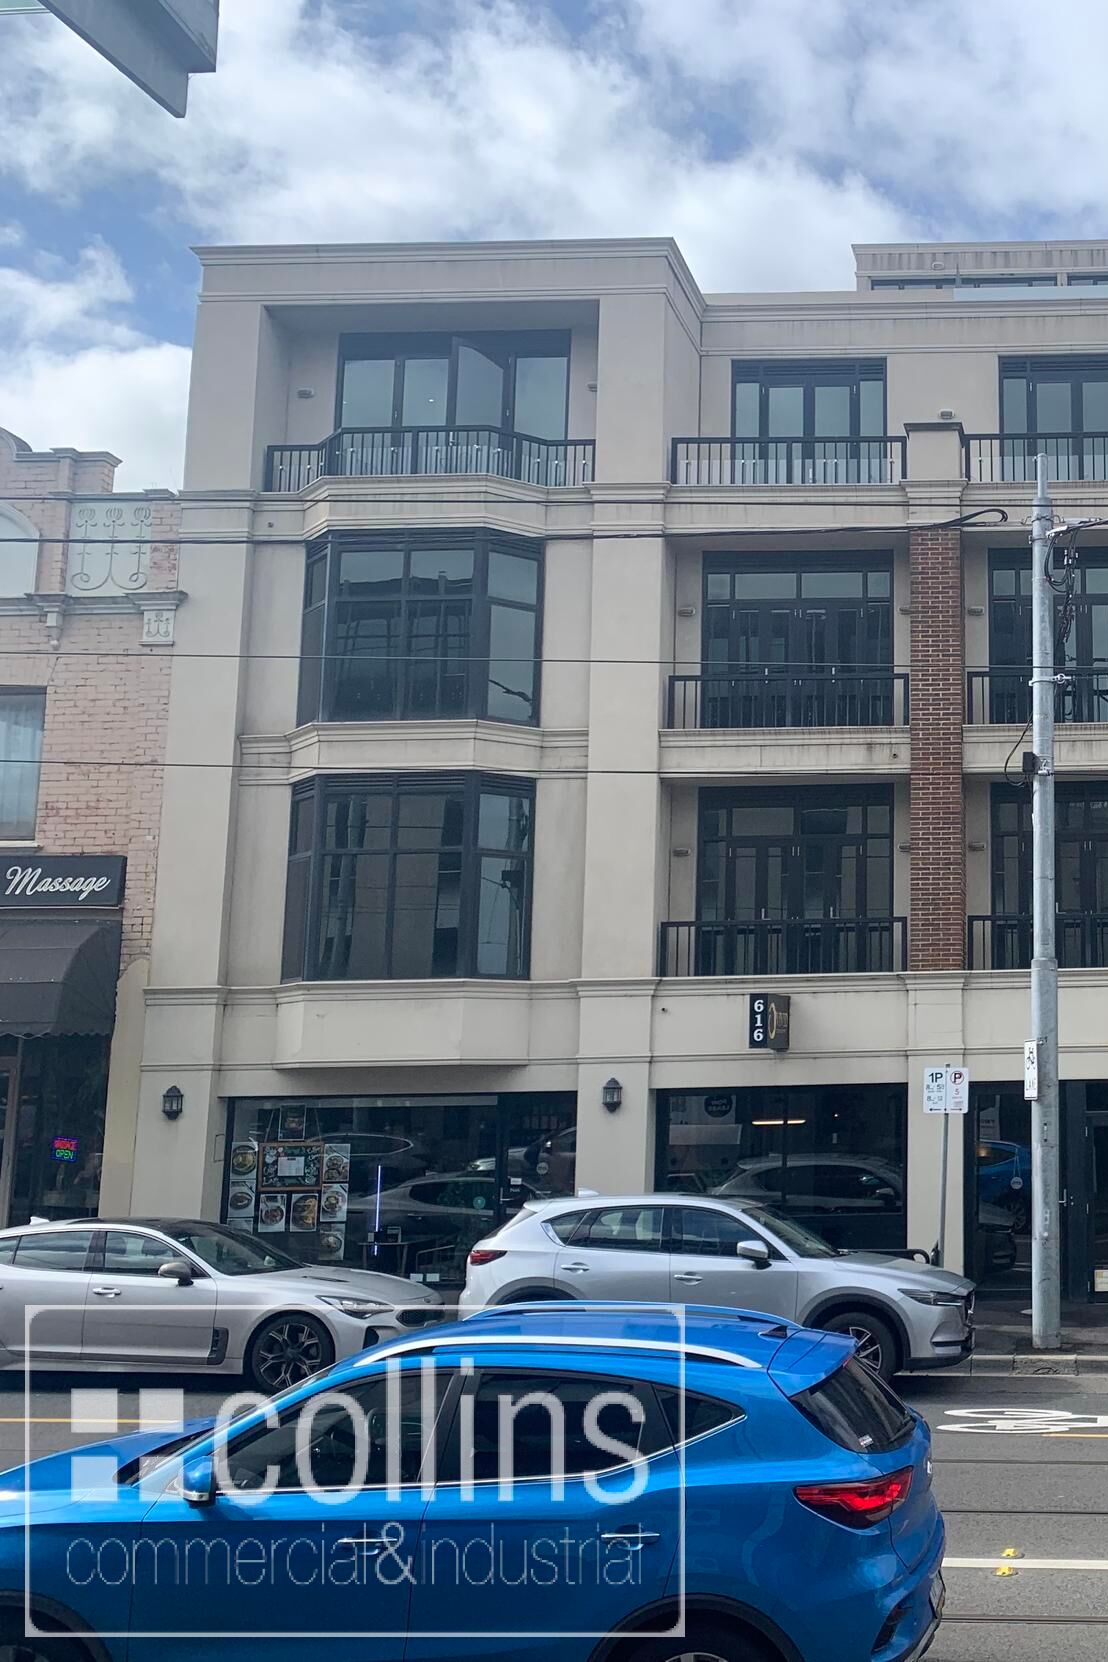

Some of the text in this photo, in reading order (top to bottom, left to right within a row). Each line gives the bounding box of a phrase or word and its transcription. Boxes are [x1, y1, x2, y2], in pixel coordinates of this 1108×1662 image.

[5, 866, 111, 901] Massage
[928, 1072, 943, 1083] 1P
[56, 1149, 74, 1160] OPEN
